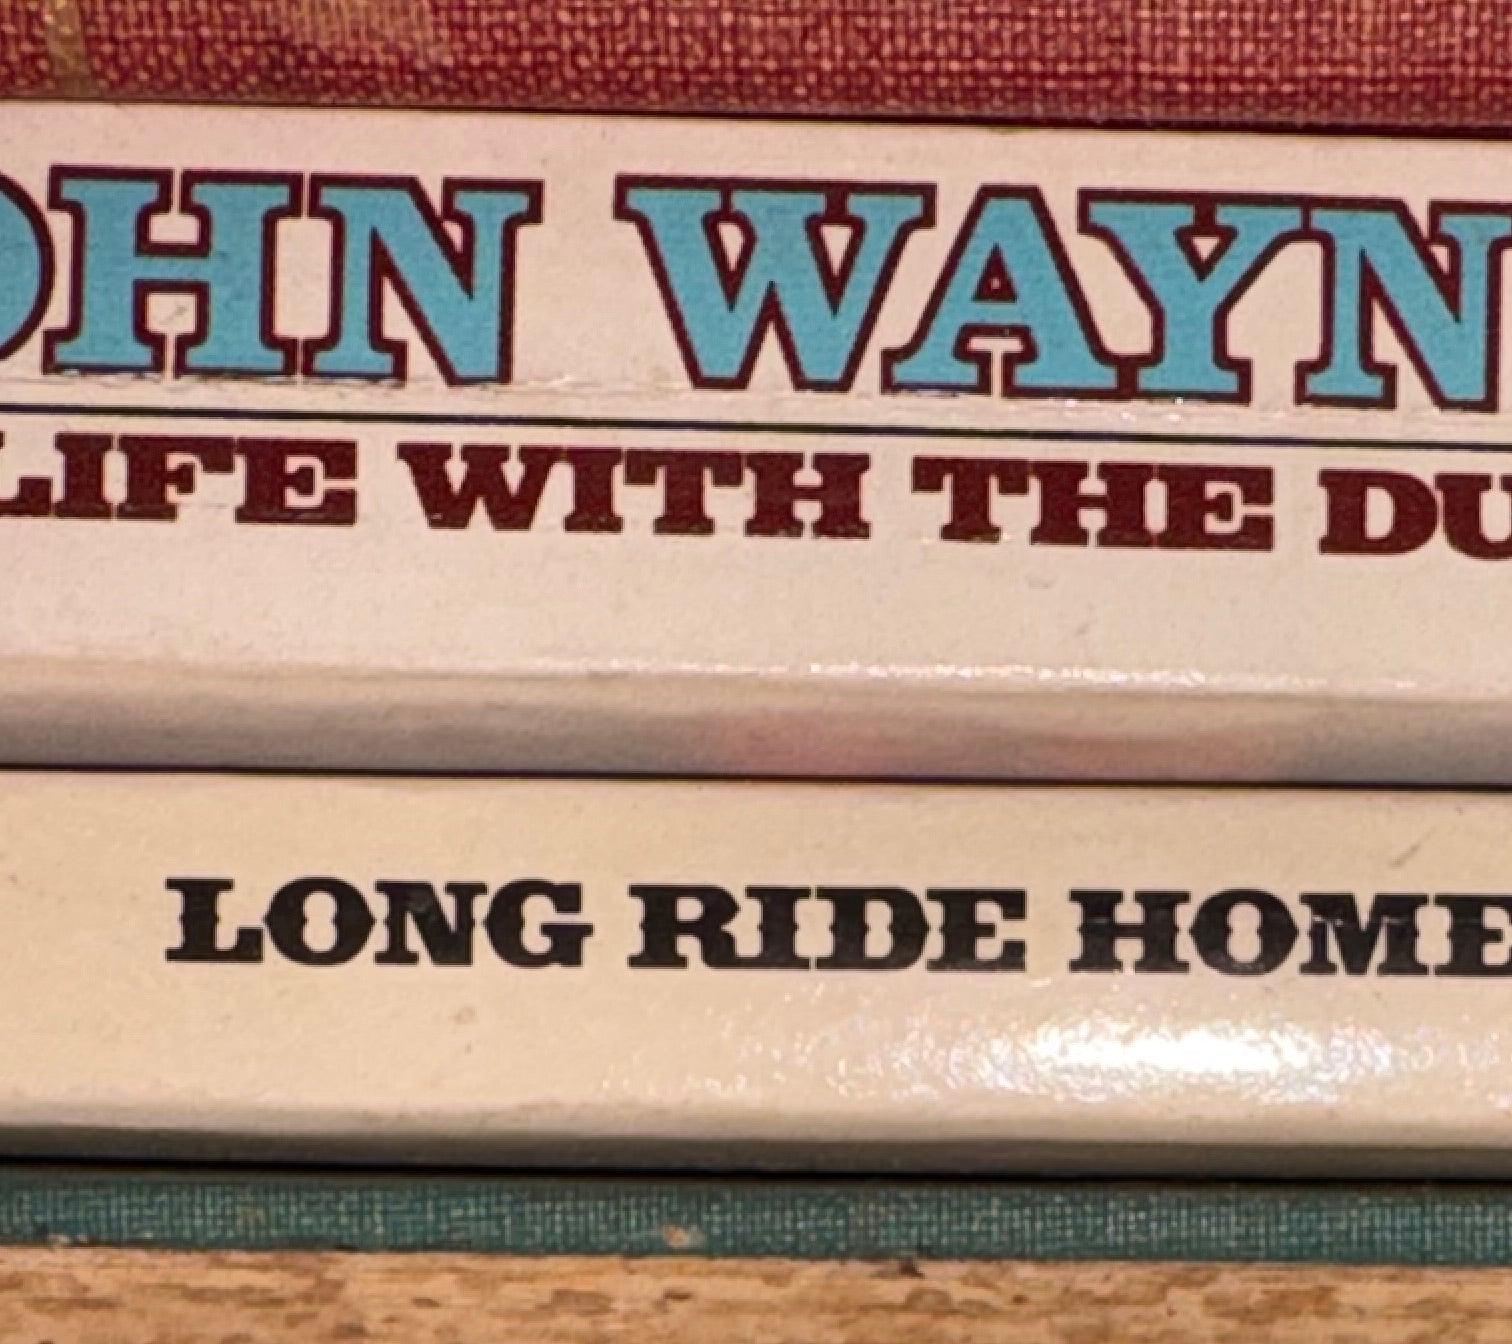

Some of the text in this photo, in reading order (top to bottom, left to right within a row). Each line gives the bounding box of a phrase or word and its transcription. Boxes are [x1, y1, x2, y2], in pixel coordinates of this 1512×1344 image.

[396, 442, 871, 541] WITH
[912, 456, 1274, 552] THE
[165, 876, 594, 969] LONG
[627, 884, 1027, 973] RIDE
